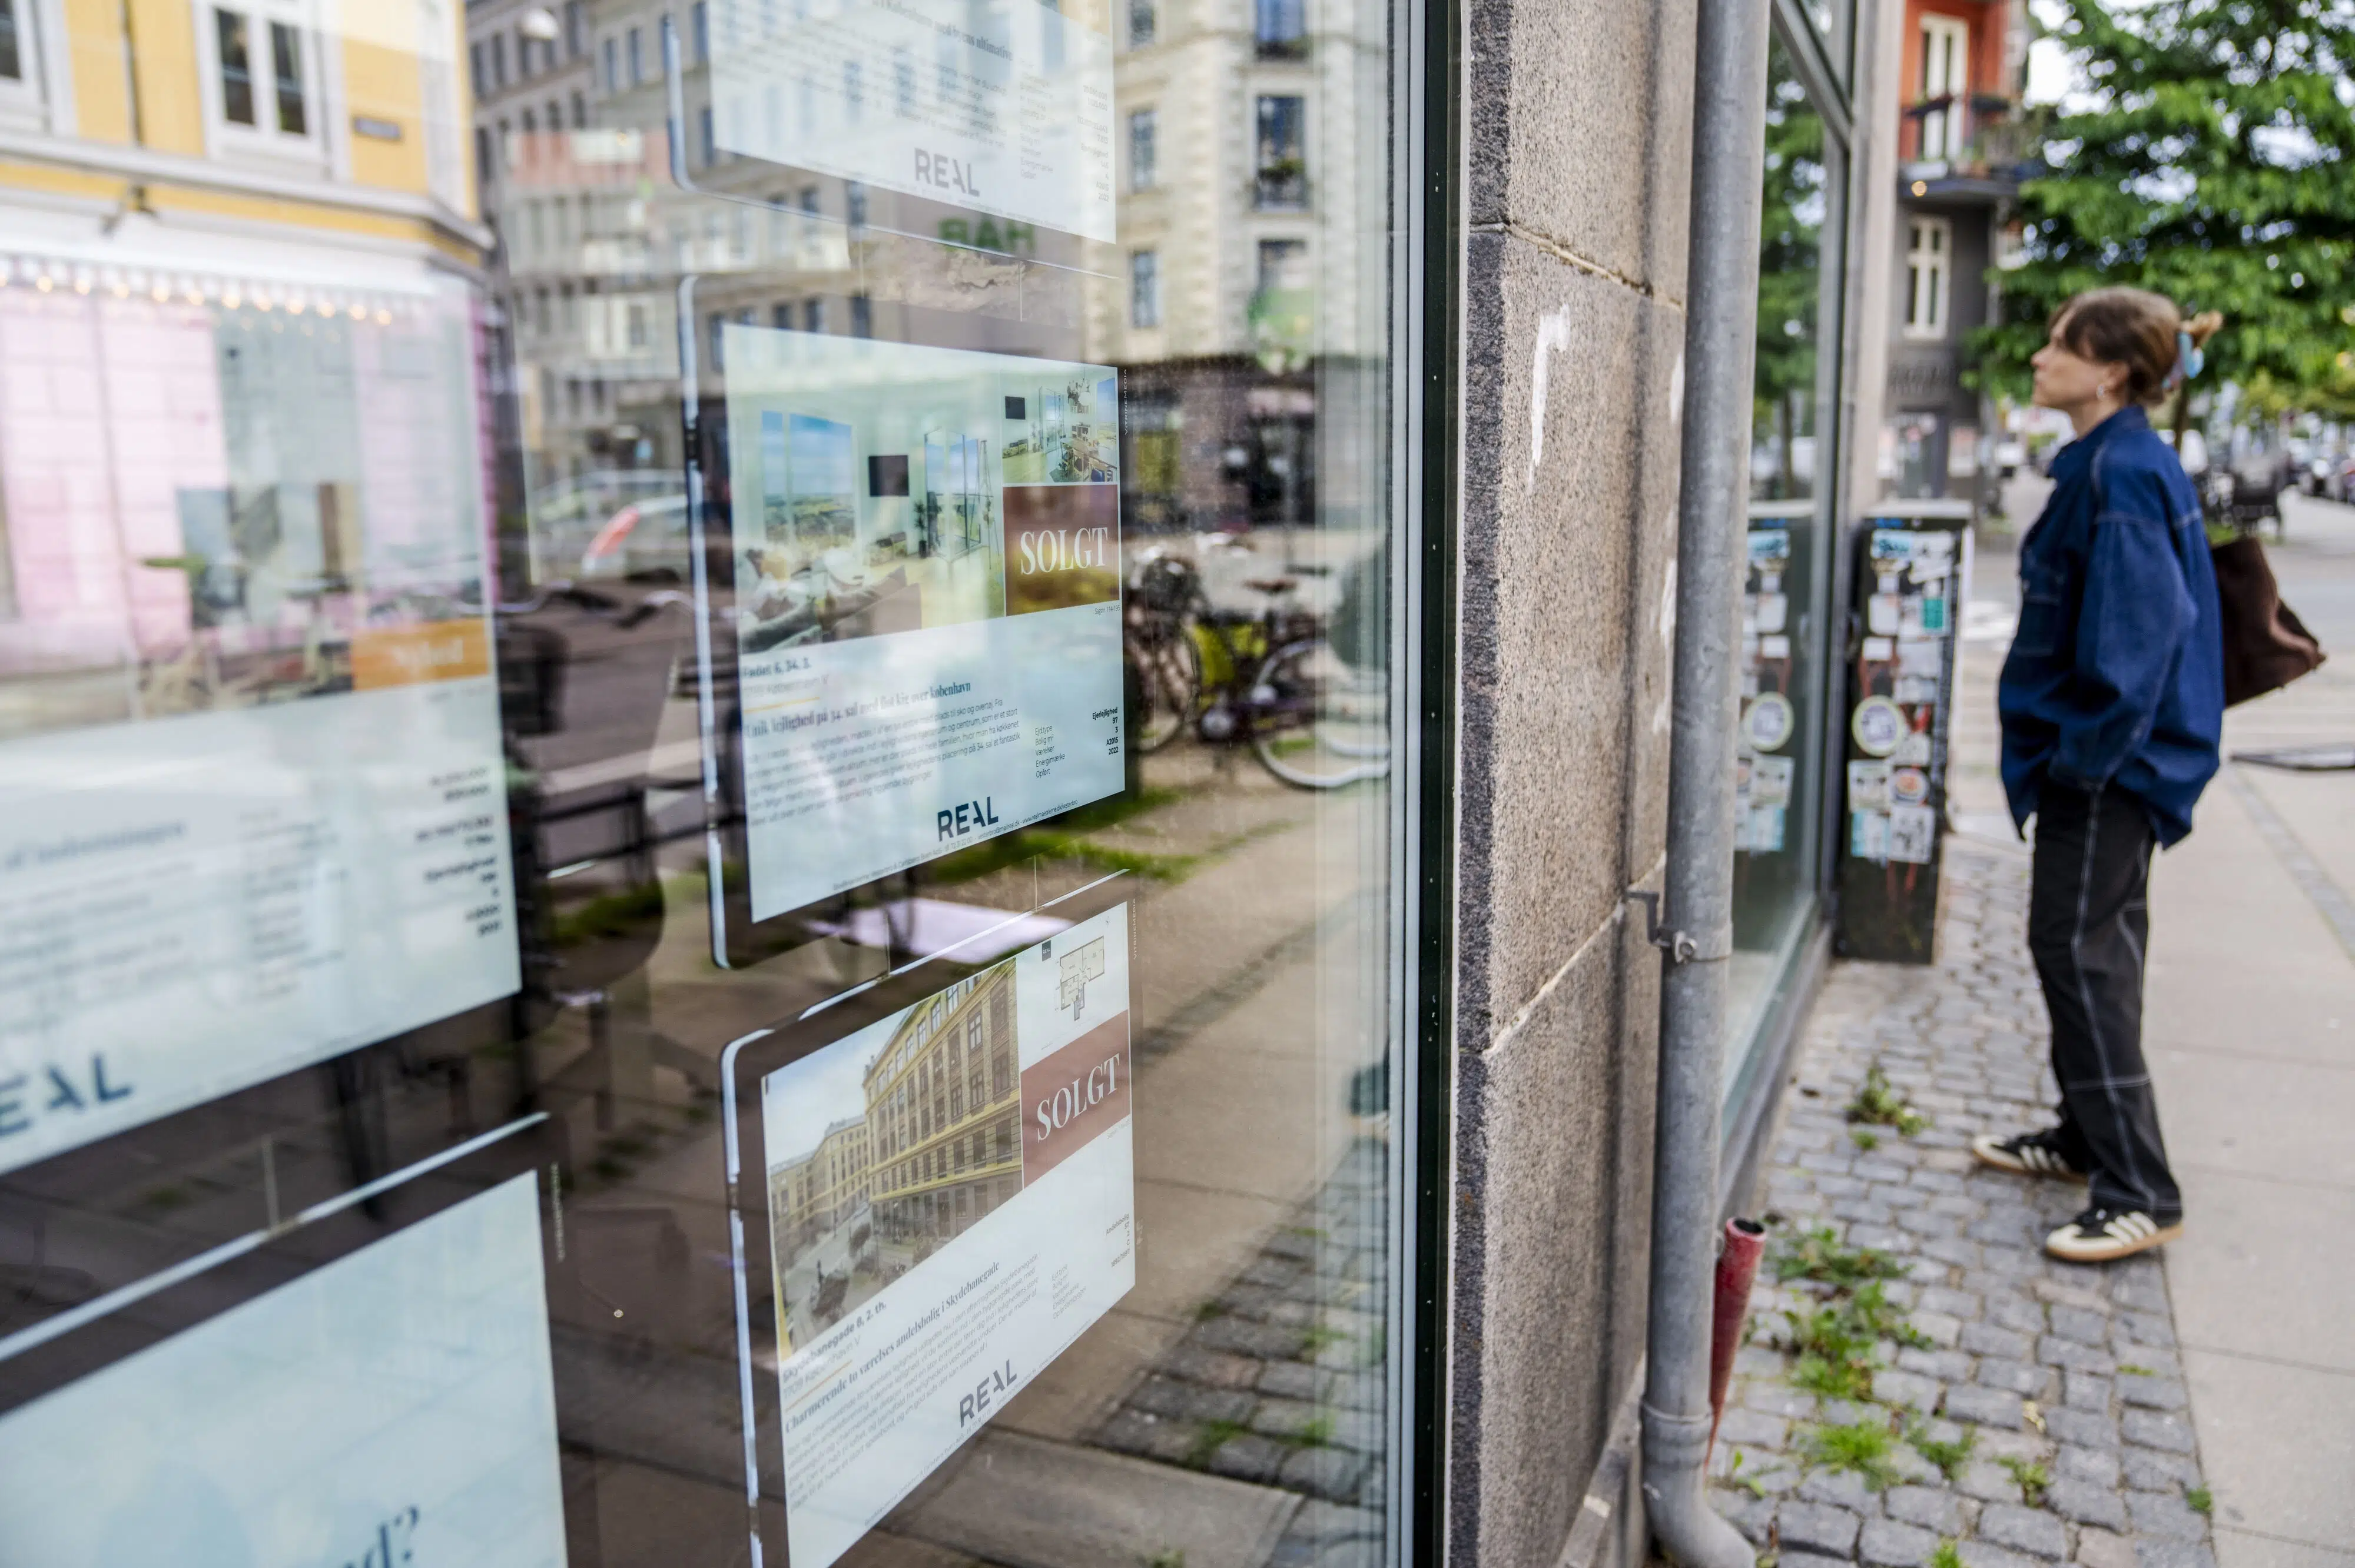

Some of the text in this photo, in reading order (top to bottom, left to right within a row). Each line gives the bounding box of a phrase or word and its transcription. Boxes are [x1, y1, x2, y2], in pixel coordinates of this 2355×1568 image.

[914, 148, 980, 197] REAL
[1020, 527, 1107, 575] SOLGT
[948, 723, 955, 732] og
[1006, 707, 1017, 717] stort
[967, 706, 974, 715] og
[1092, 706, 1117, 720] Ejerlejlighed
[976, 729, 988, 738] man
[1035, 737, 1046, 745] Bolig
[1035, 746, 1054, 756] Værelser
[1036, 736, 1118, 767] Energimærke A2015
[1036, 746, 1118, 778] Opført 2022
[937, 796, 999, 842] REAL
[1037, 1053, 1120, 1142] SOLGT
[896, 1305, 940, 1348] andelsbolig
[946, 1260, 999, 1310] Skydebanegade
[960, 1359, 1017, 1428] REAL
